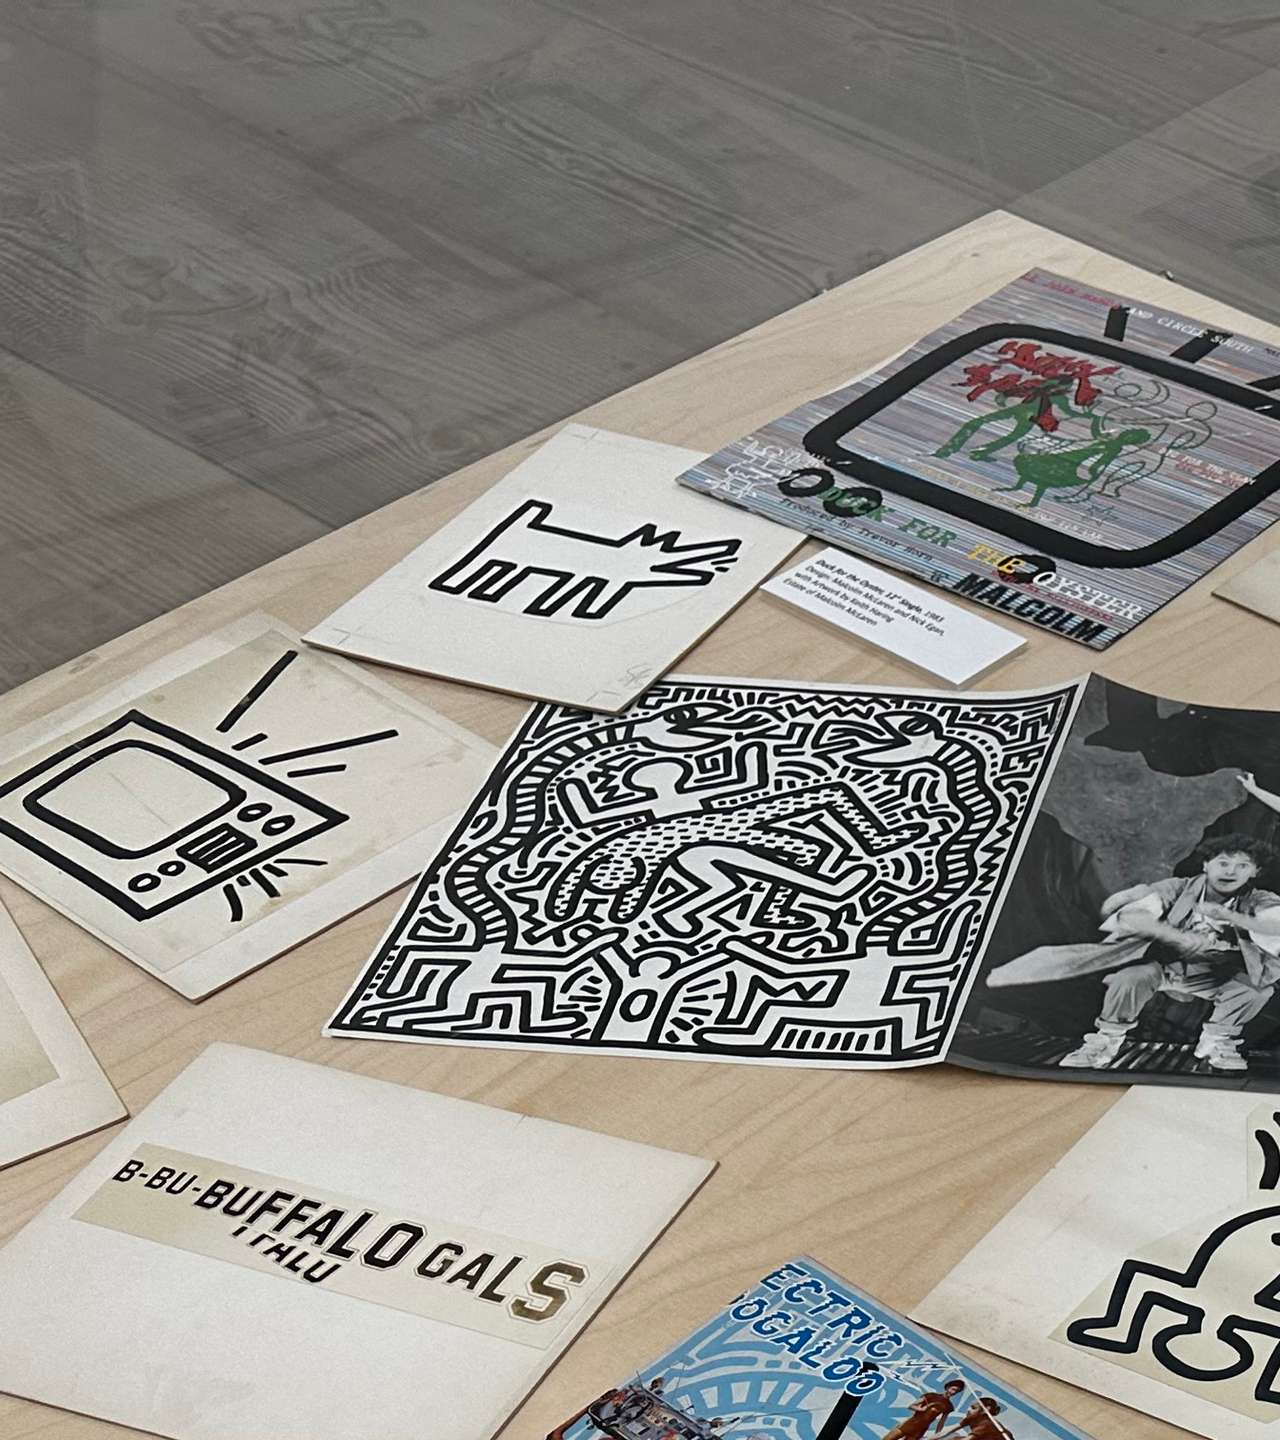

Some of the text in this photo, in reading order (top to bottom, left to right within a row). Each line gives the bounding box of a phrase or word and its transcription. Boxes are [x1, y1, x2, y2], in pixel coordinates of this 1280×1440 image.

[818, 485, 895, 522] DUCK
[898, 516, 958, 547] FOR
[967, 543, 1025, 573] THE
[1032, 571, 1143, 621] OYSTER
[954, 572, 1107, 643] MALCOLM
[414, 1241, 589, 1324] GALS
